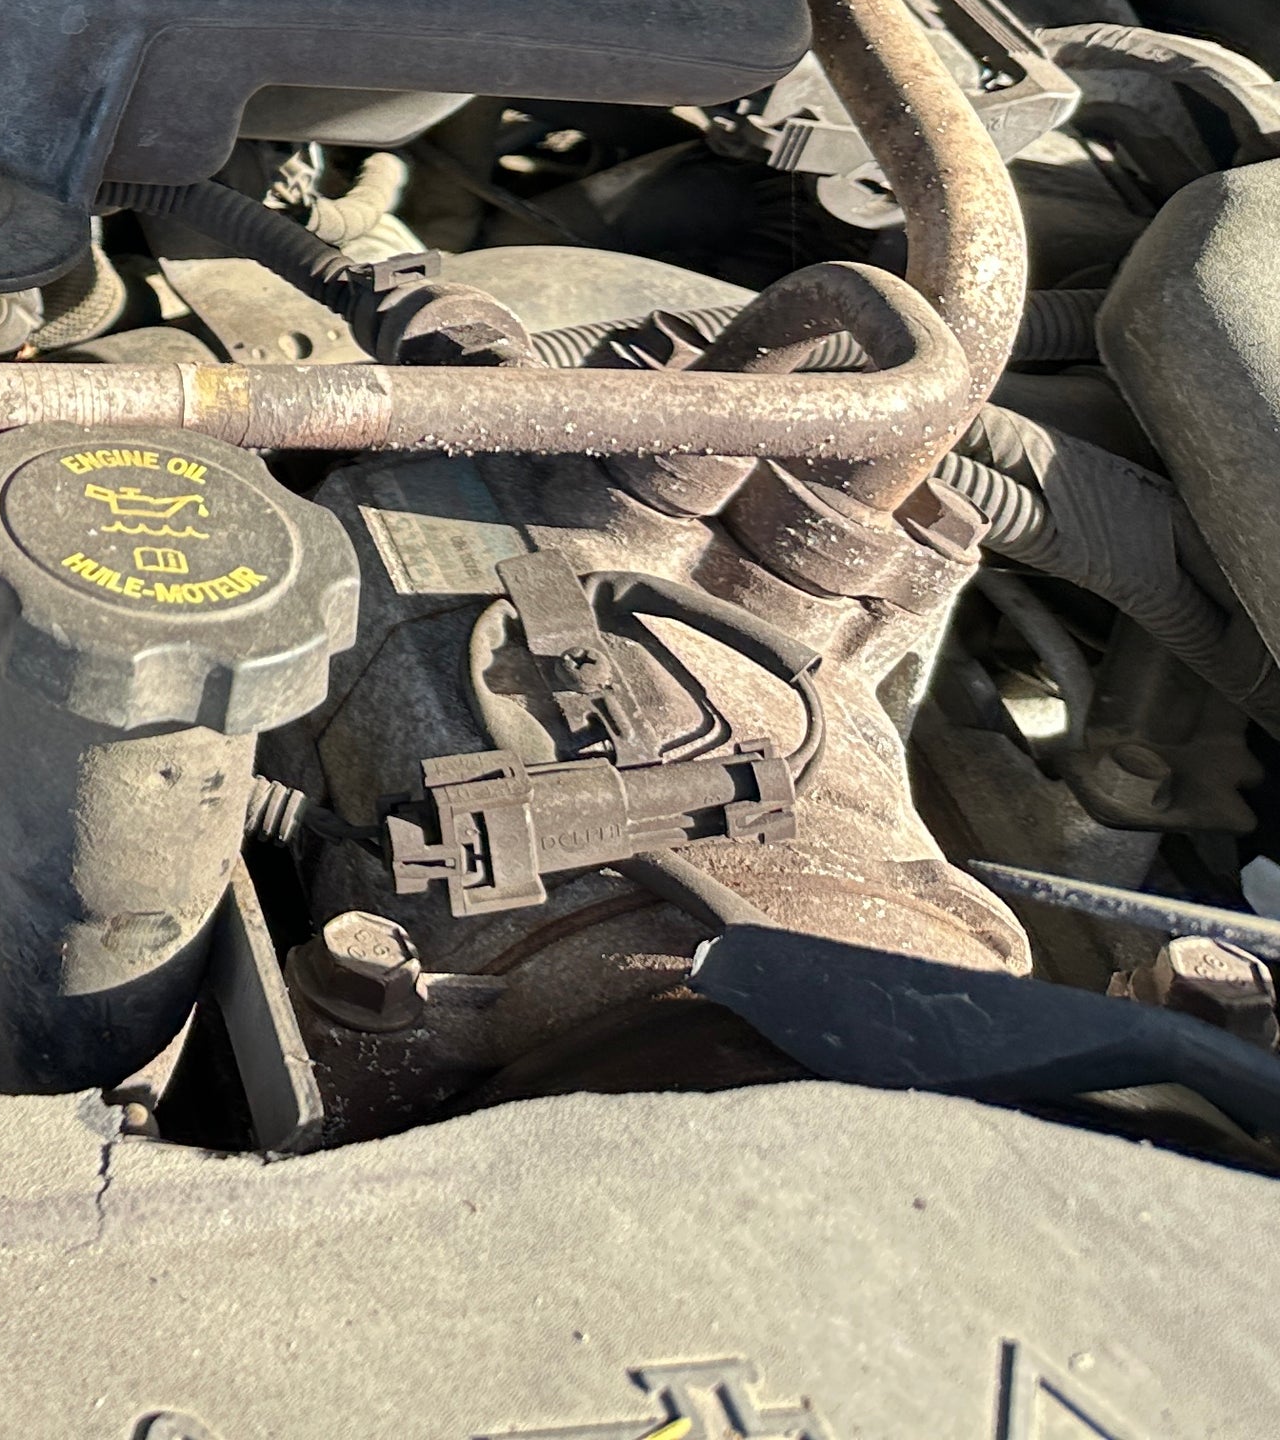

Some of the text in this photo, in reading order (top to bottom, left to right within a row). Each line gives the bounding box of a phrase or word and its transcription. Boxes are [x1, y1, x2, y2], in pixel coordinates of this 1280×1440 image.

[60, 449, 209, 485] ENGINE OIL
[61, 552, 269, 604] HUILE-MOTEUR
